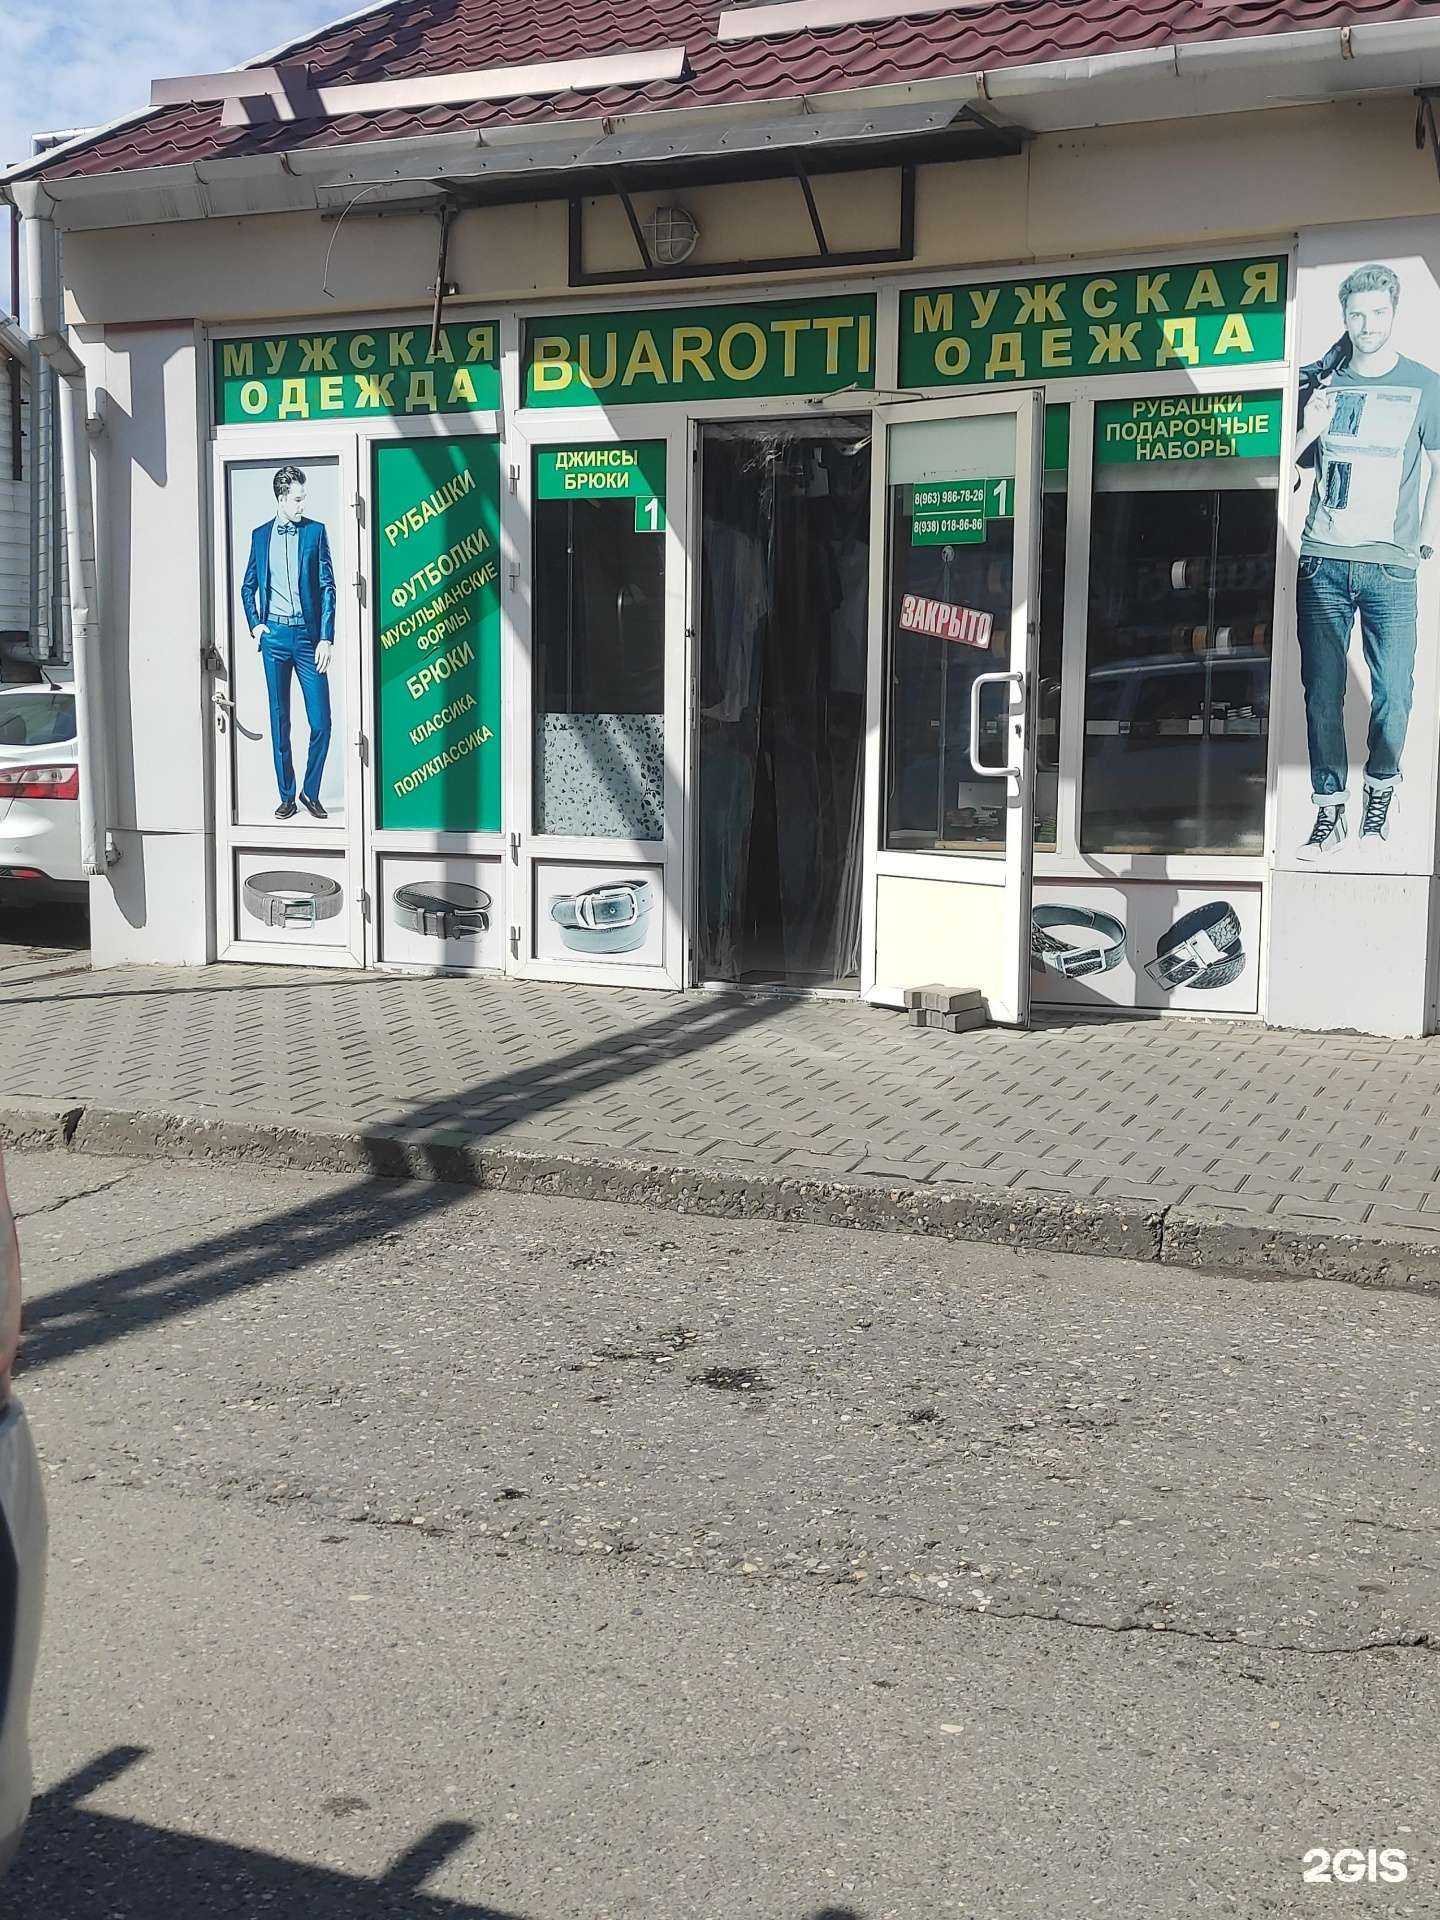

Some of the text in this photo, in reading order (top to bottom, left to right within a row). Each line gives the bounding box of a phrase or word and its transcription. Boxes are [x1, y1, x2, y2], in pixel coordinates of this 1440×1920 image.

[913, 263, 1279, 333] МУЖСКАЯ
[224, 326, 494, 376] МУЖСКАЯ
[533, 315, 872, 392] BUAROTTI
[934, 313, 1254, 379] ОДЕЖДА
[240, 368, 478, 419] ОДЕЖДА
[1132, 395, 1243, 419] РУБАШКИ
[1106, 414, 1269, 442] ПОДАРОЧНЫЕ
[1136, 438, 1236, 461] НАБОРЫ
[555, 449, 638, 469] ДЖИНСЫ
[564, 472, 629, 490] БРЮКИ
[384, 469, 477, 547] РУБАШКИ
[644, 497, 659, 530] 1
[914, 491, 941, 507] 8(963)
[993, 479, 1007, 516] 1
[913, 520, 940, 535] 8(938)
[391, 527, 491, 608] ФУТБОЛКИ
[380, 562, 498, 650] МУСУЛЬМАНСКИЕ
[417, 607, 471, 650] ФОРМЫ
[901, 596, 991, 645] ЗАКРЫТО
[406, 641, 475, 700] БРЮКИ
[409, 693, 478, 746] КЛАССИКА
[393, 725, 495, 798] ПОЛУКЛАССИКА
